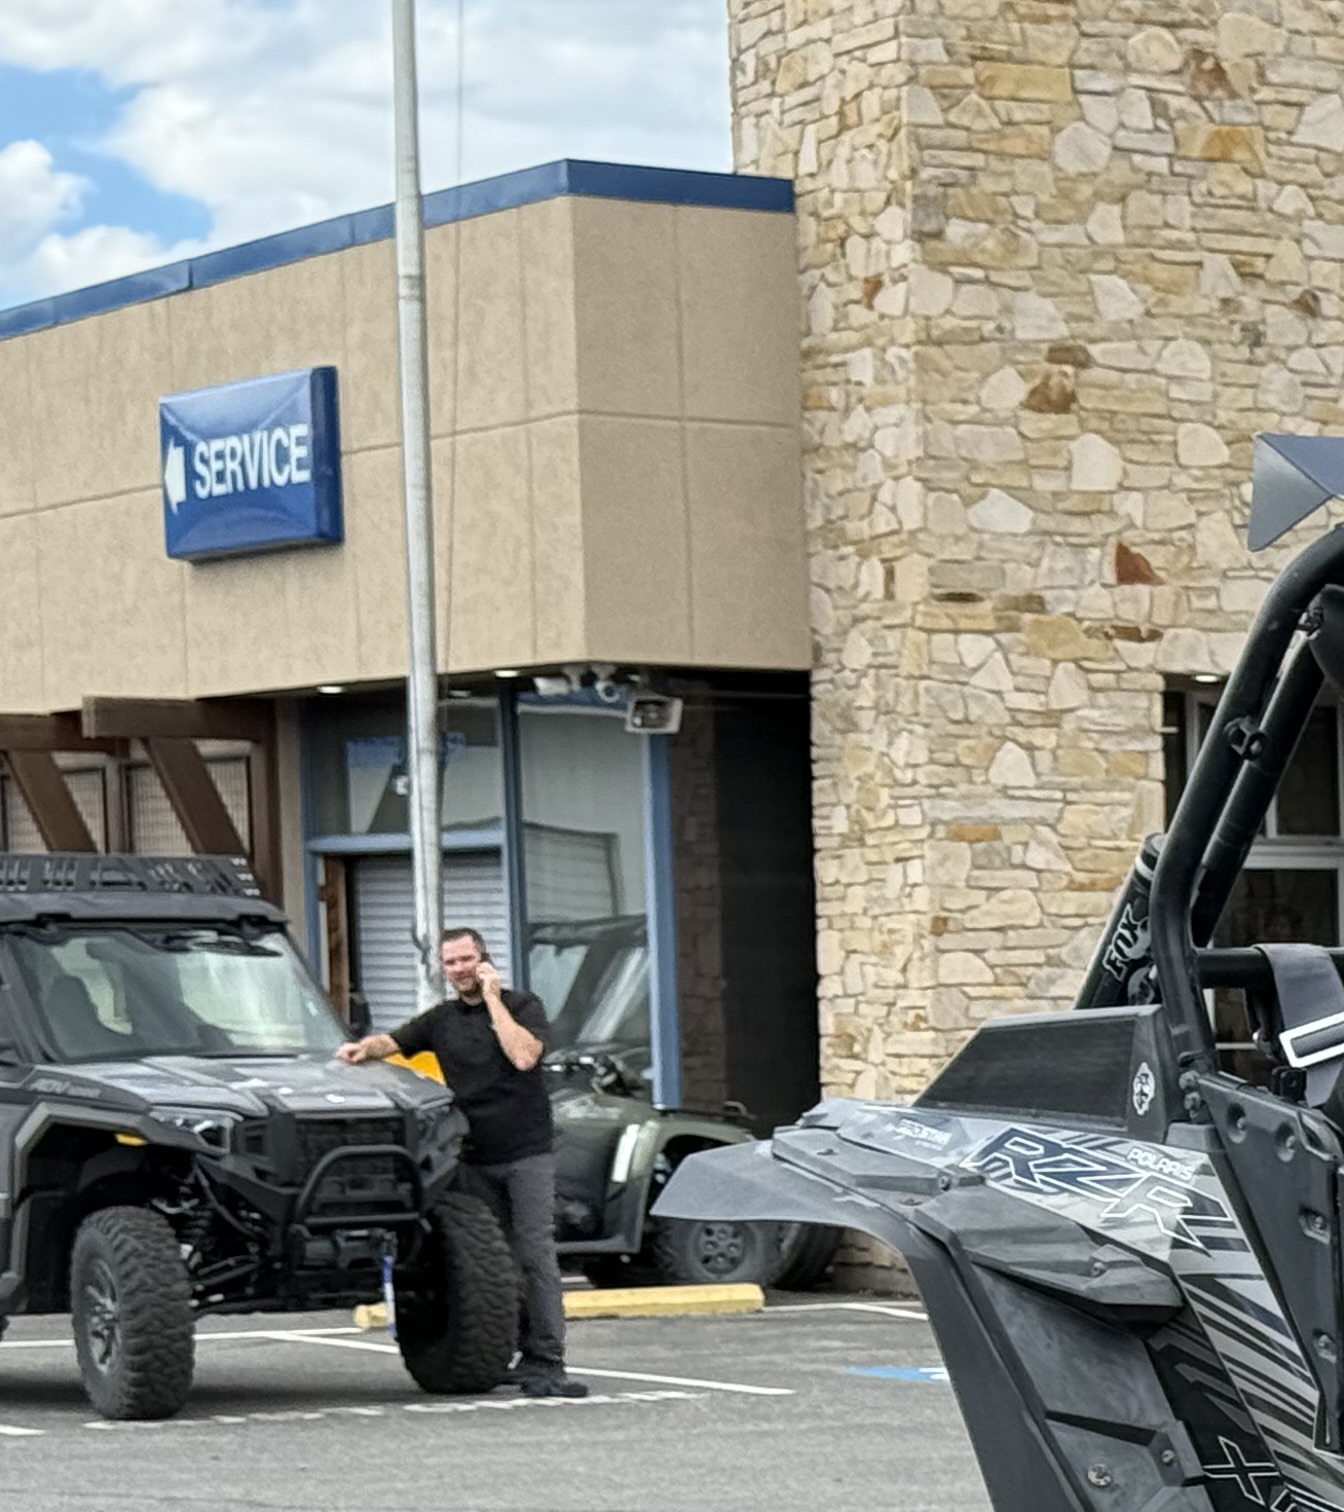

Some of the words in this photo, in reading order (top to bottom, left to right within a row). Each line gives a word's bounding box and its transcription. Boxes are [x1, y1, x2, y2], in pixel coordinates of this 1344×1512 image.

[193, 423, 312, 500] SERVICE
[957, 1125, 1233, 1257] RZR
[1127, 1146, 1197, 1181] POLARIS
